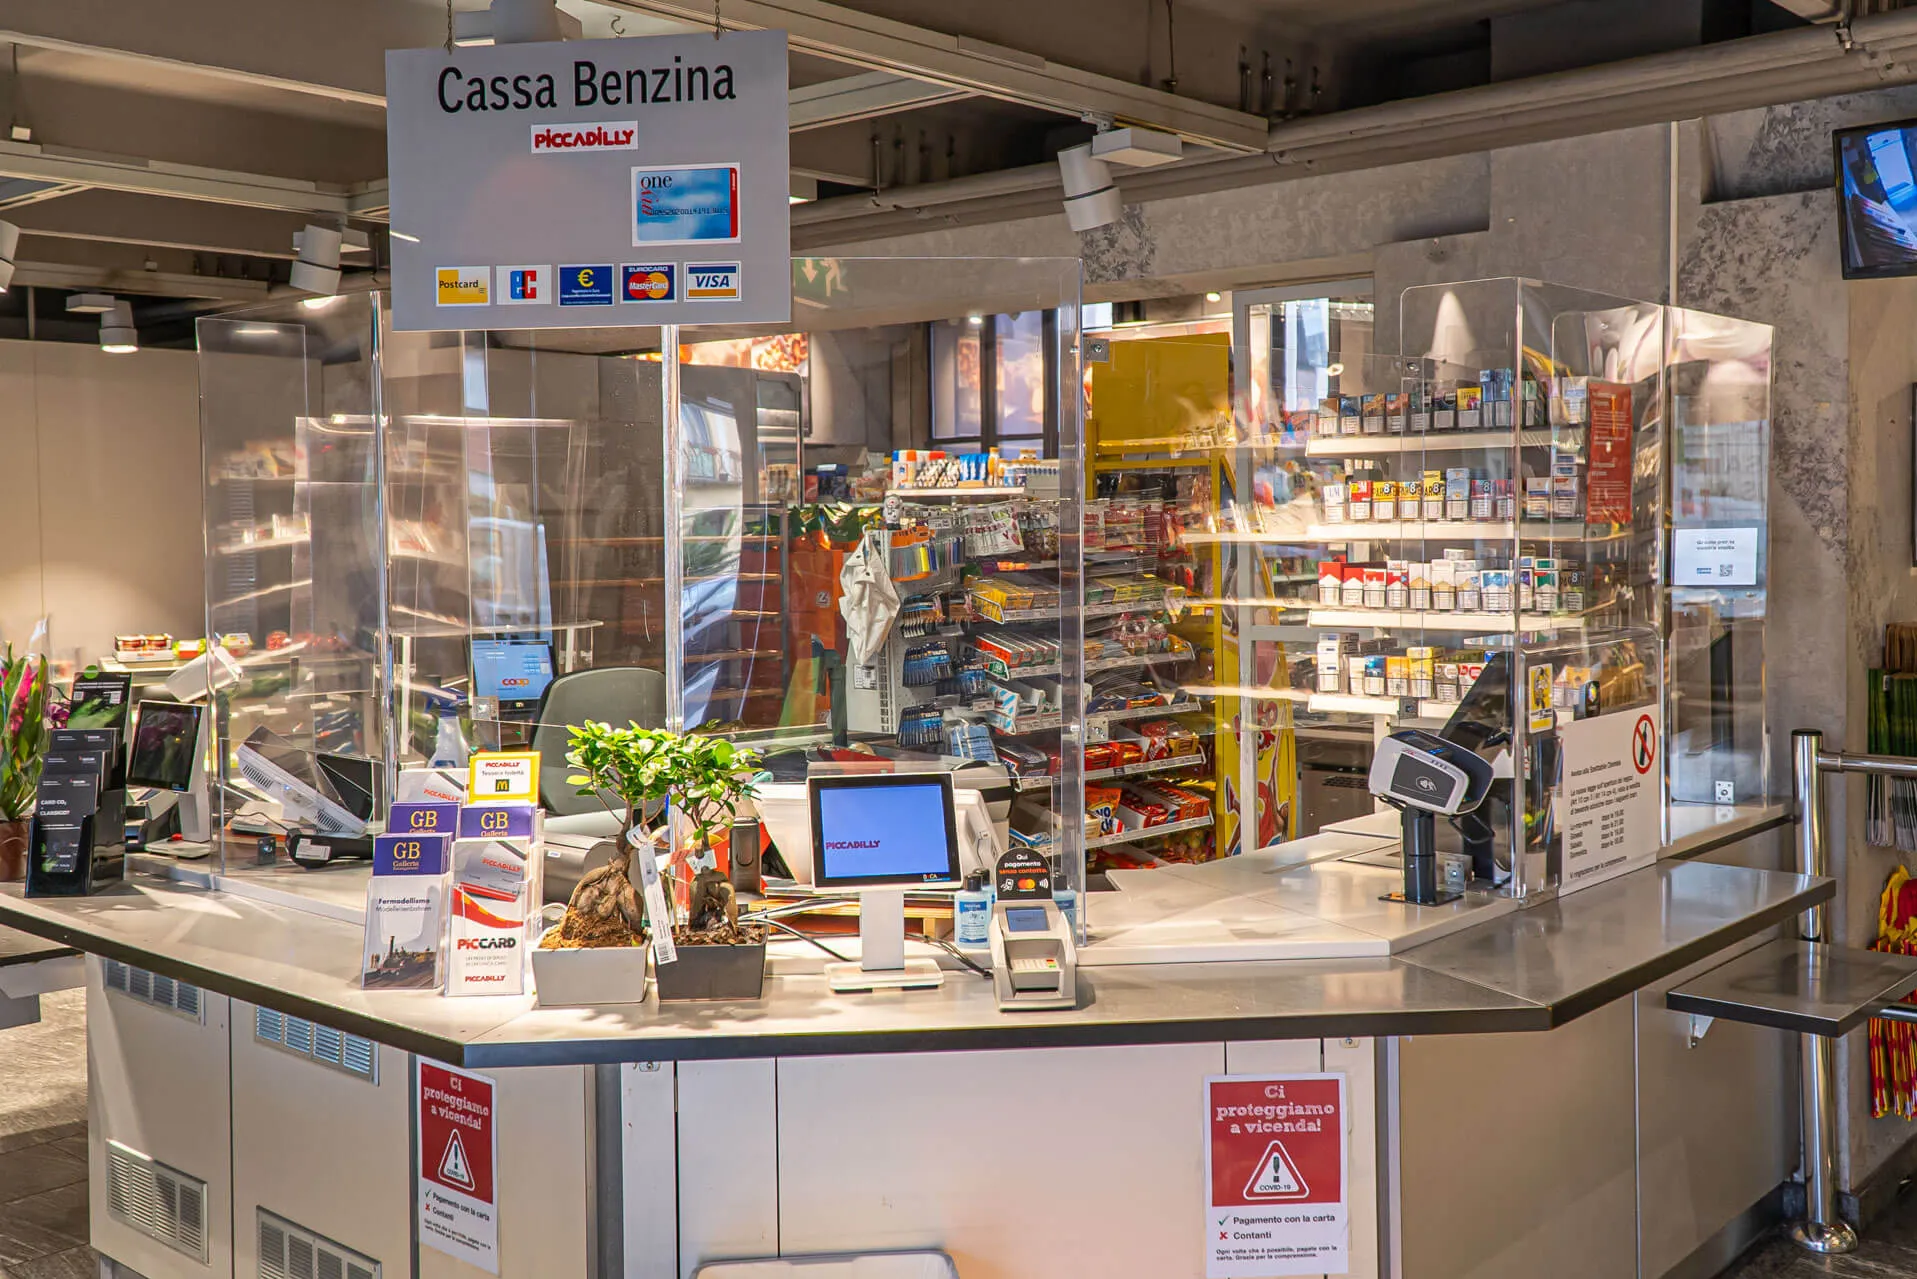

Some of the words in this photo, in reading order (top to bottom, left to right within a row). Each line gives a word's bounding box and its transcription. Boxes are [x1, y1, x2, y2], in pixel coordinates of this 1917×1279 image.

[437, 66, 558, 114] Cassa
[573, 55, 737, 107] Benzina
[640, 174, 672, 189] one
[438, 279, 479, 289] Postcard
[629, 281, 668, 290] MasterCard
[695, 275, 730, 288] VISA
[410, 810, 438, 828] GB
[480, 811, 509, 829] GB
[393, 841, 421, 859] GB
[825, 840, 880, 850] PICCADILLY
[457, 937, 517, 950] PICCARD
[450, 1076, 462, 1092] Ci
[1264, 1085, 1286, 1099] Ci
[423, 1085, 489, 1116] proteggiamo
[430, 1104, 437, 1115] a
[438, 1106, 482, 1130] vicenda!
[1215, 1102, 1335, 1121] proteggiamo
[1230, 1124, 1241, 1134] a
[1244, 1118, 1322, 1133] vicenda!
[1259, 1184, 1291, 1192] COVID-19
[1233, 1215, 1282, 1226] Pagamento
[1302, 1214, 1311, 1222] la
[1312, 1214, 1336, 1222] carta
[1233, 1231, 1272, 1240] Contanti
